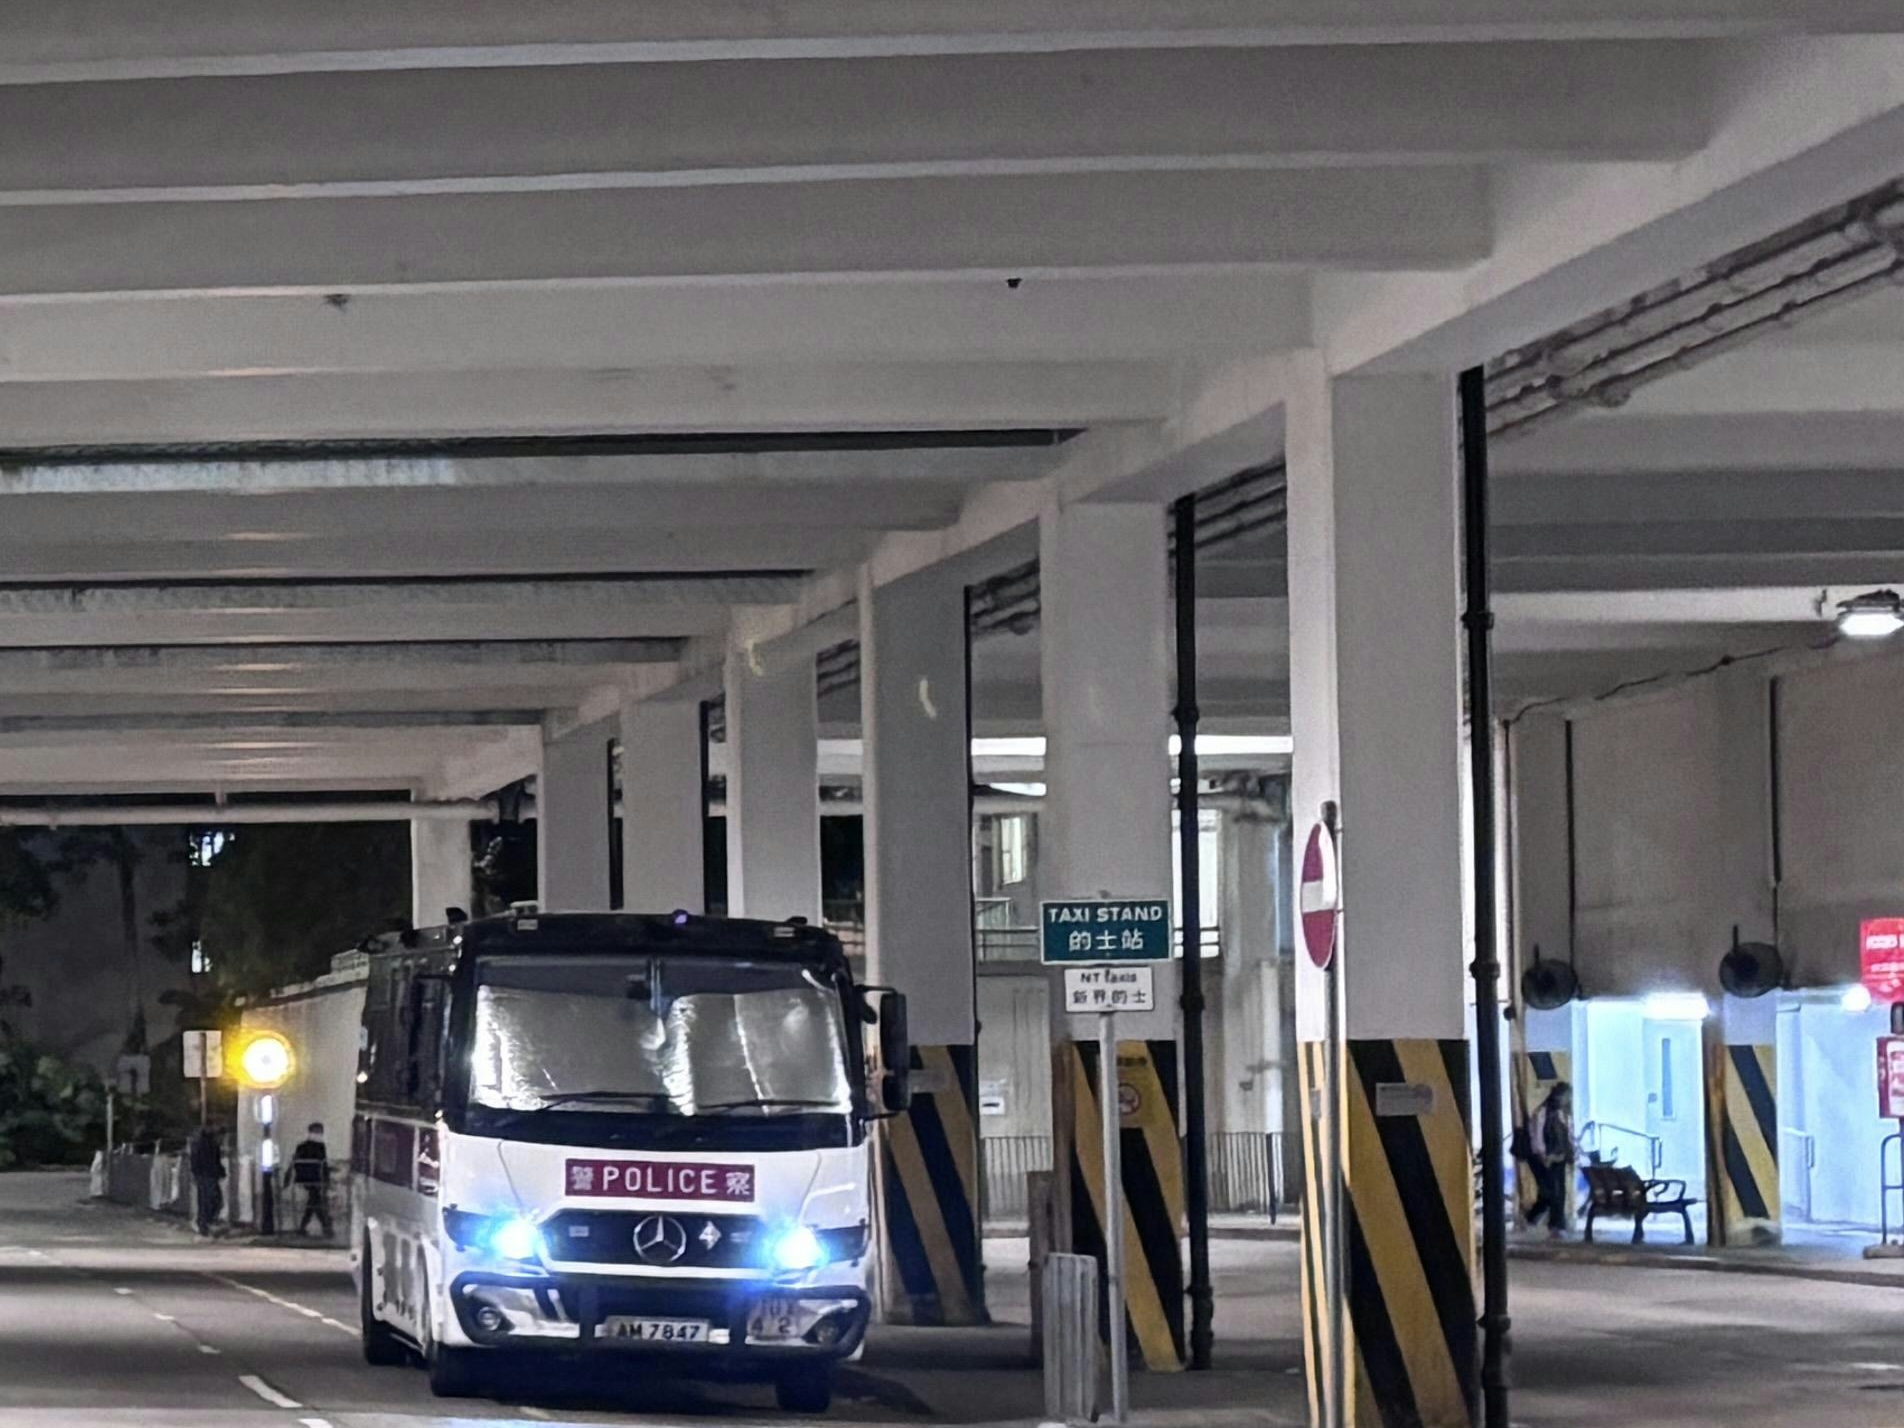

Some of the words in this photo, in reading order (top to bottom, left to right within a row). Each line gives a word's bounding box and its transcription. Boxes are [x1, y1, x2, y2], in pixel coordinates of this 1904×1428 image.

[1048, 907, 1090, 923] TAXI
[1096, 906, 1162, 922] STAND
[1068, 928, 1144, 951] 的士站
[602, 1165, 718, 1194] POLICE
[725, 1171, 751, 1195] 察
